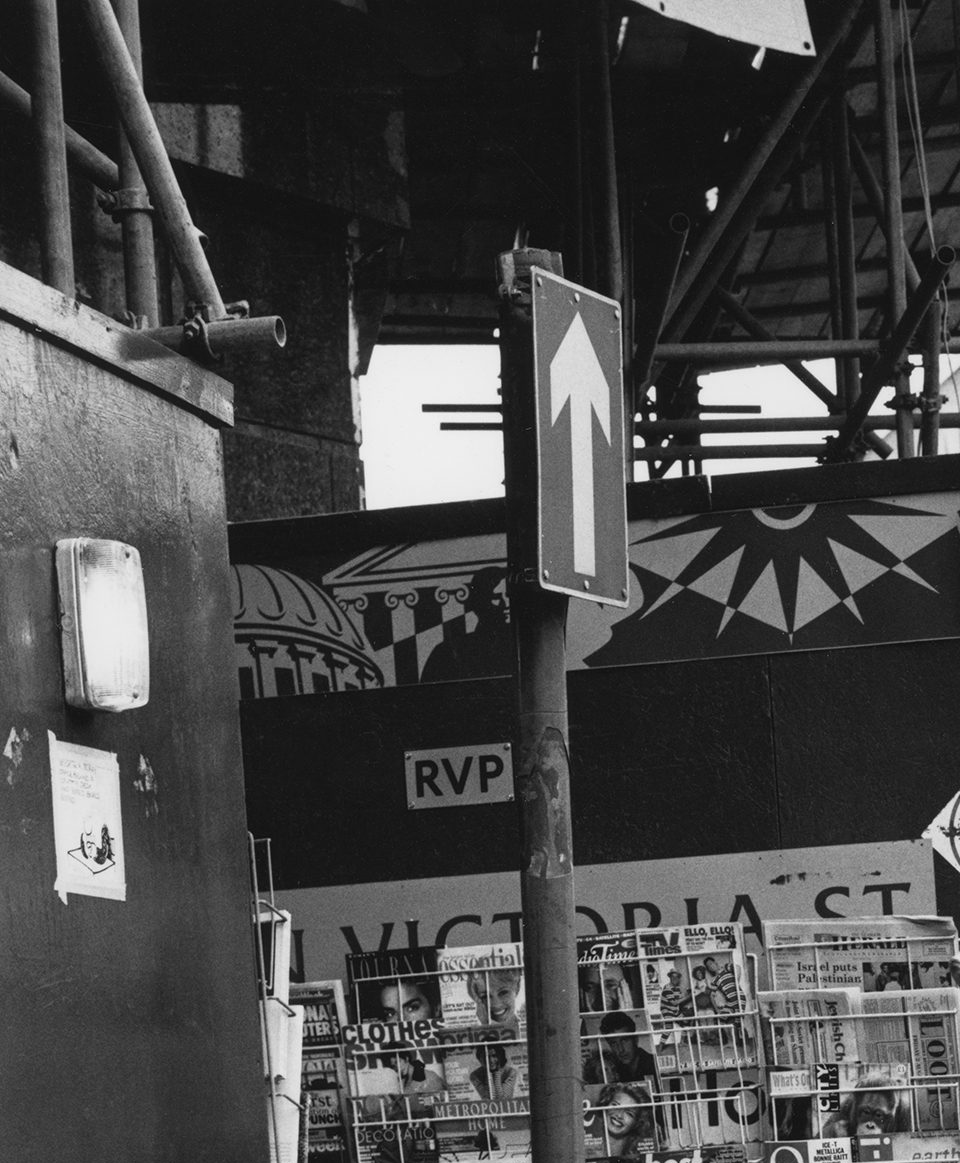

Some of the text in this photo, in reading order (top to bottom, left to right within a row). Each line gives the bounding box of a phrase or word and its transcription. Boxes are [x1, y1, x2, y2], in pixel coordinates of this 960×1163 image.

[415, 755, 505, 798] RVP
[684, 926, 735, 938] ELLO, ELLO!
[835, 963, 858, 973] puts
[346, 1037, 443, 1070] SHW
[816, 1063, 830, 1112] CITY
[357, 1127, 435, 1144] DECOATIO
[815, 1147, 845, 1156] METALLICA
[912, 1149, 960, 1161] earth
